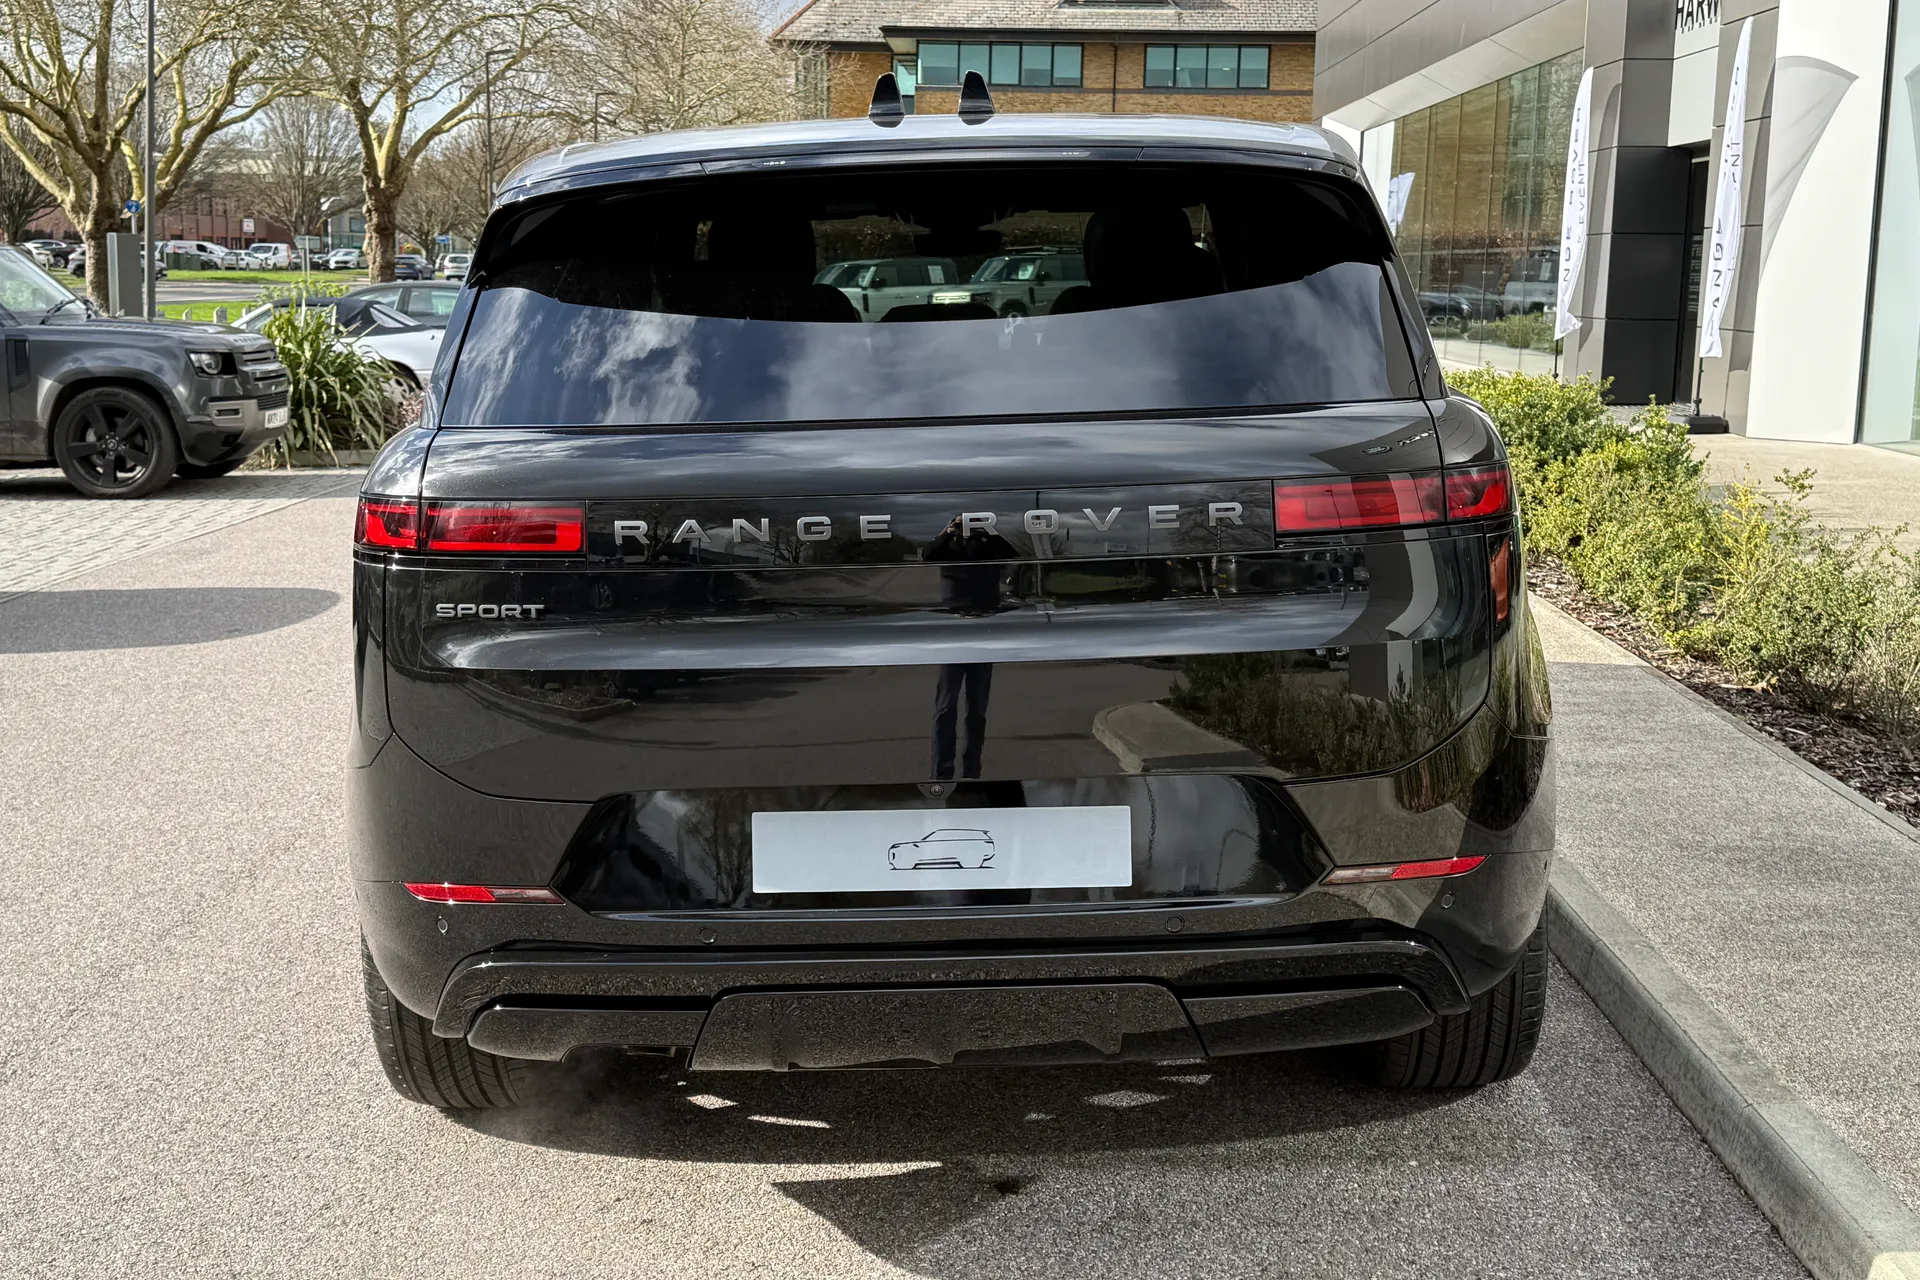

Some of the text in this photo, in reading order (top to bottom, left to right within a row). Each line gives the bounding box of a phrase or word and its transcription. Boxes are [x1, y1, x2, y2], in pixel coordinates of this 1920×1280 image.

[613, 502, 1244, 545] RANGE ROVER
[435, 603, 546, 618] SPORT
